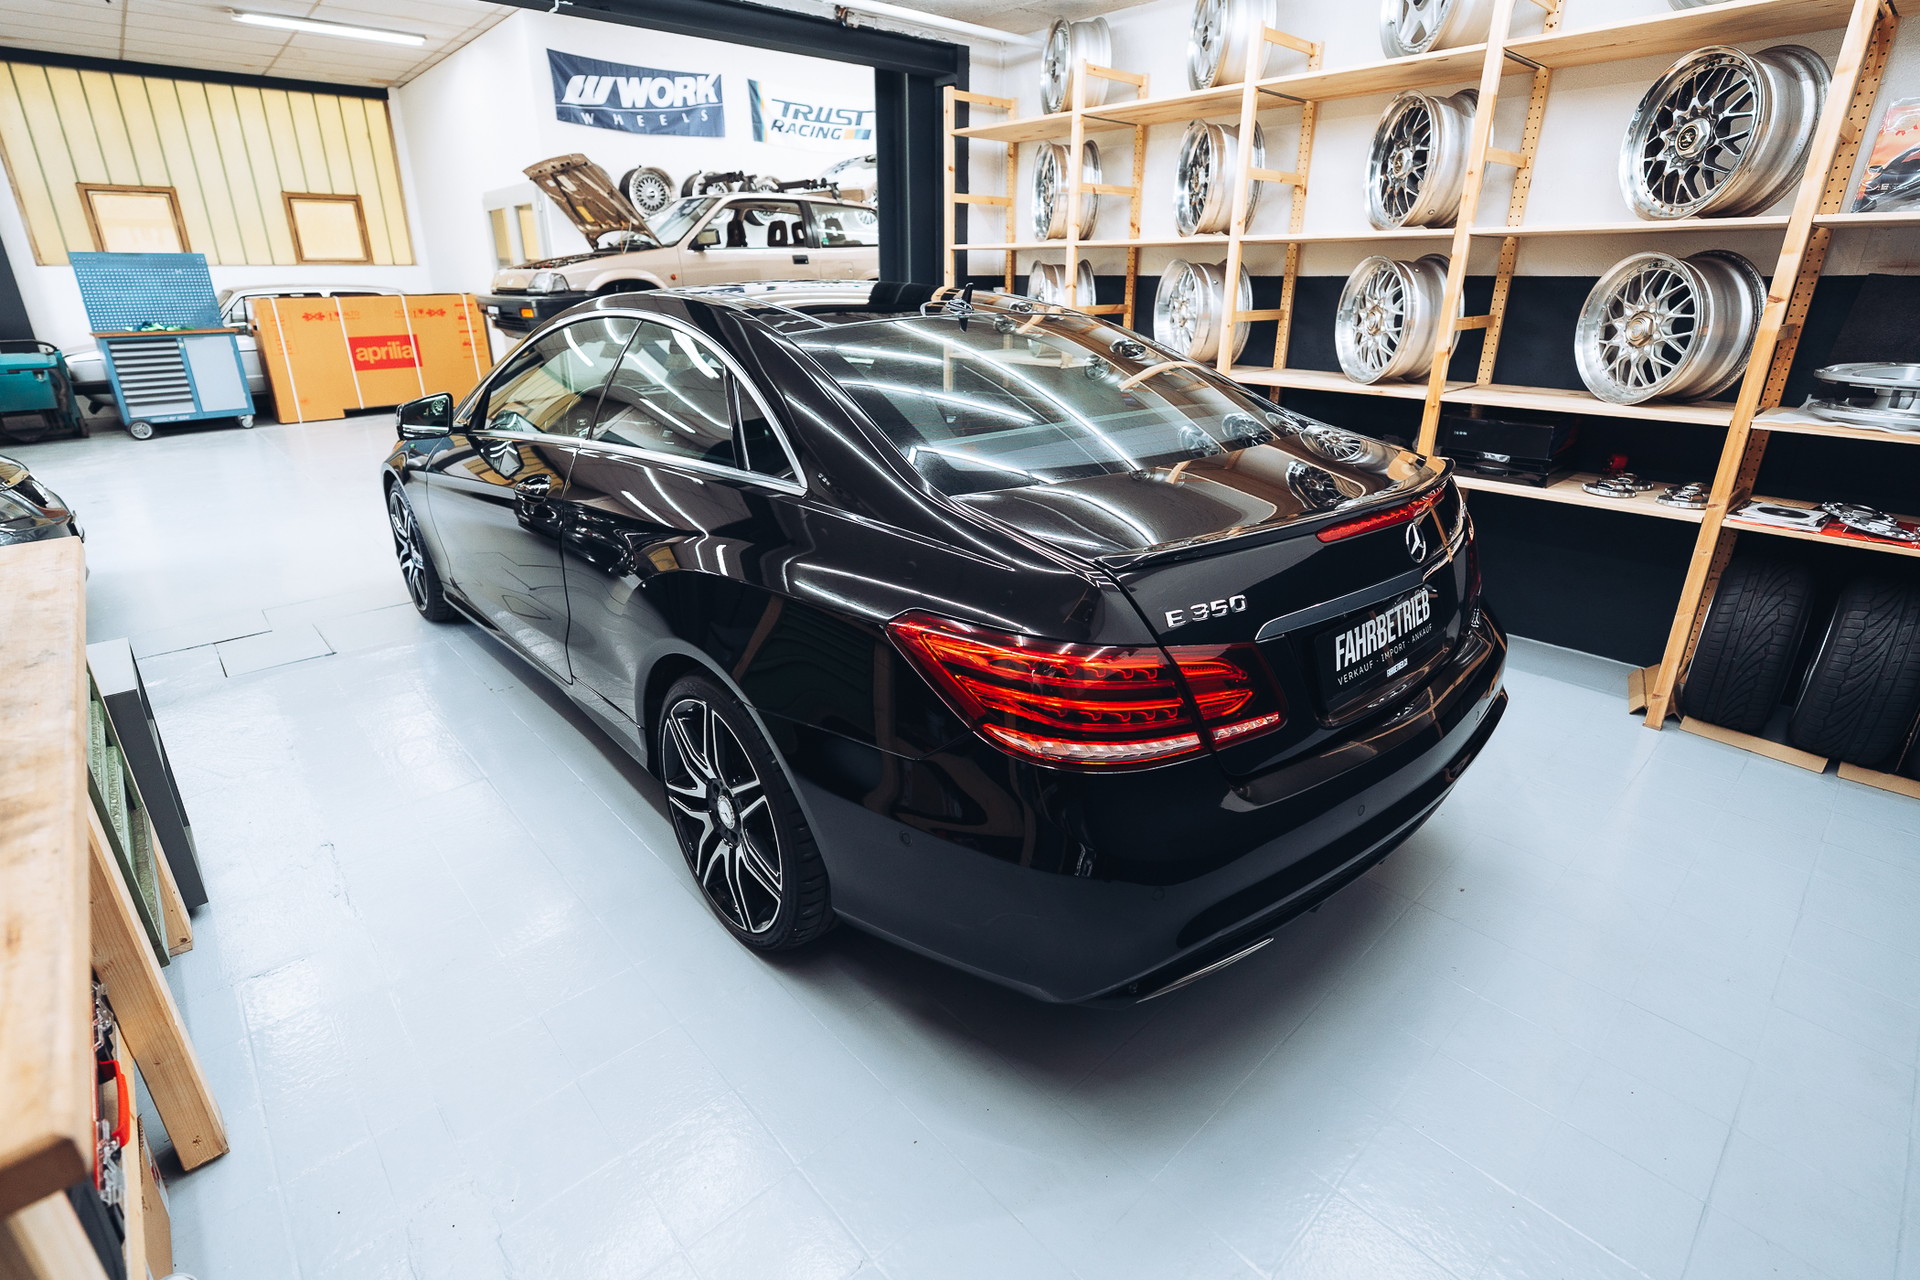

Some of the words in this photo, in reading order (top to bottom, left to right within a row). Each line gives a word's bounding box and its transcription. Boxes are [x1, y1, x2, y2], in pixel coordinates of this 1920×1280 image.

[616, 73, 718, 108] WORK
[580, 109, 709, 127] WHEELS
[771, 98, 875, 126] TRUST
[770, 119, 843, 140] RACING
[355, 341, 414, 364] aprilia
[1164, 609, 1187, 628] E
[1190, 594, 1247, 622] 350
[1335, 589, 1431, 672] FAHRBETRIEB
[1337, 660, 1374, 686] VERKAUF
[1380, 641, 1406, 662] IMPORT
[1411, 623, 1432, 643] ANKAUF
